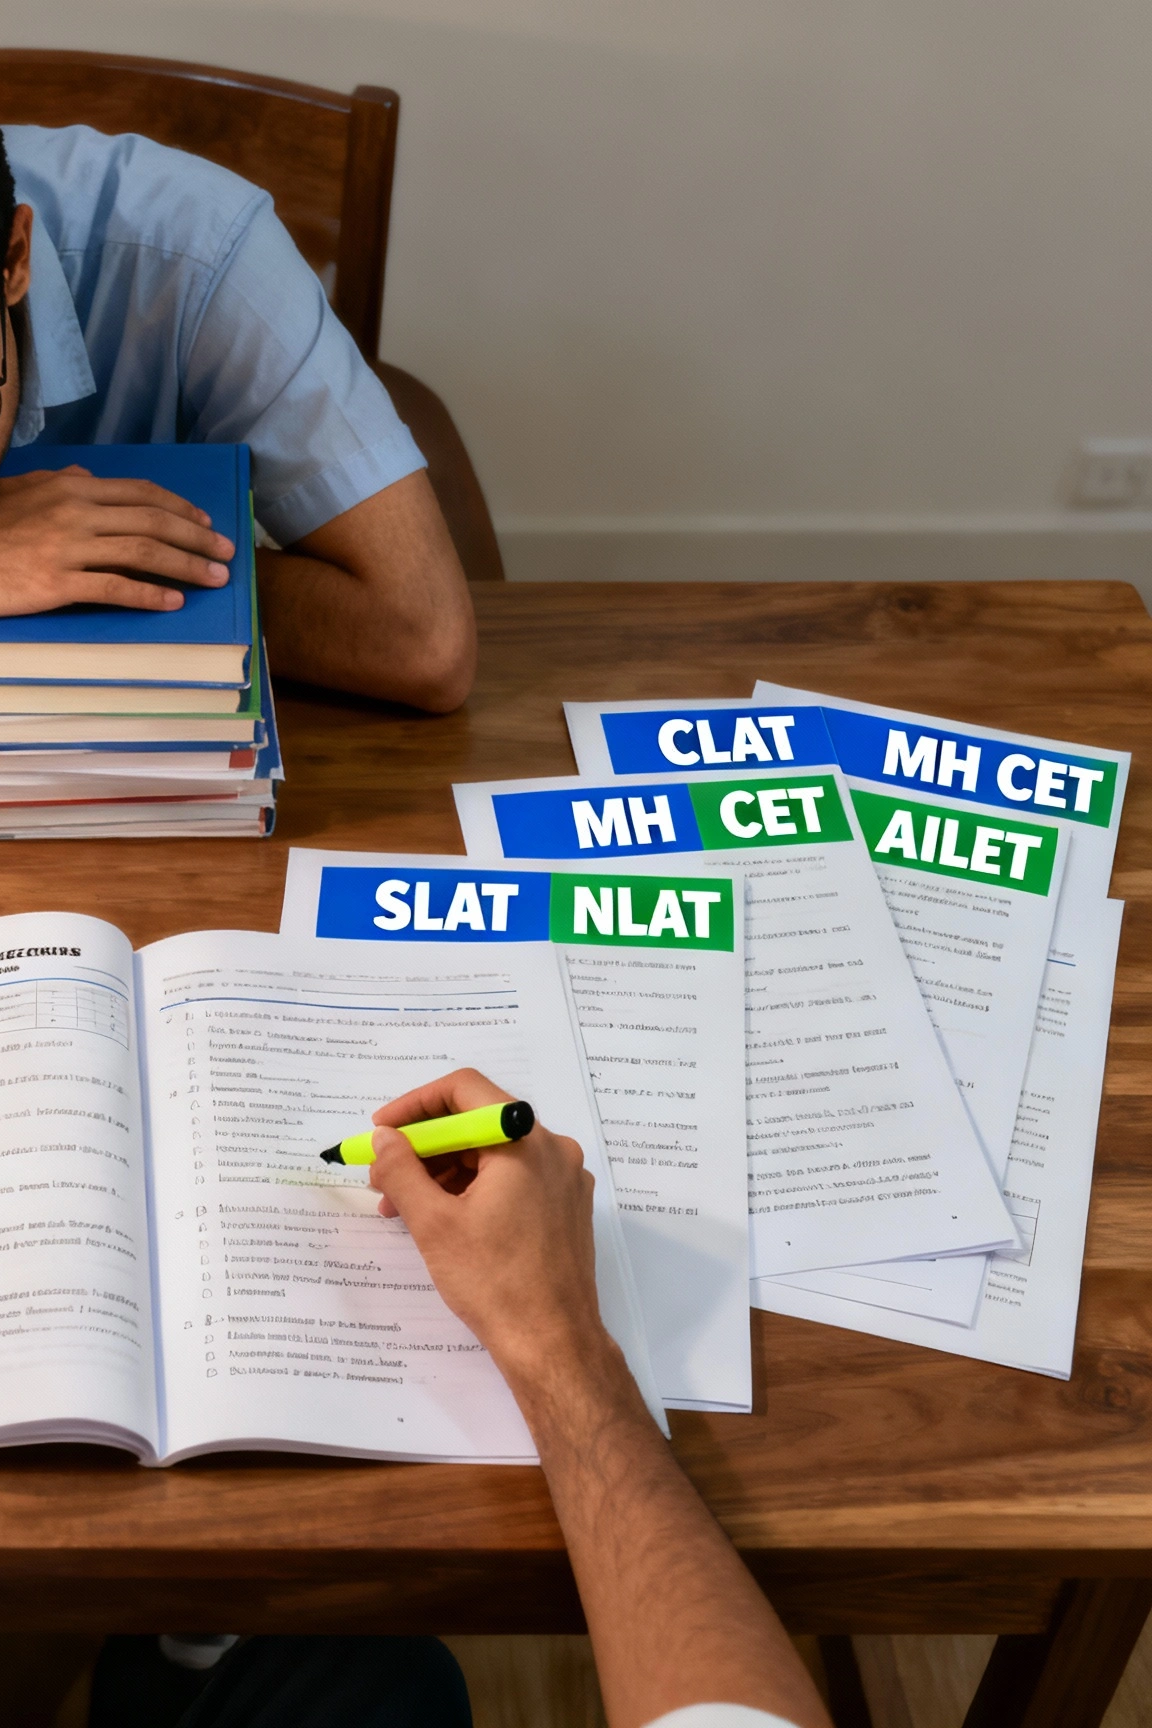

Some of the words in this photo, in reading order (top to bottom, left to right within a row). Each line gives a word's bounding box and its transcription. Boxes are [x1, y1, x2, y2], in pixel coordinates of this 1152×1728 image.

[658, 715, 795, 765] CLAT
[882, 729, 982, 792] MH
[996, 753, 1104, 813] CET
[571, 794, 677, 848] MH
[719, 786, 825, 838] CET
[874, 809, 1043, 880] AILET
[373, 879, 519, 931] SLAT
[573, 886, 721, 938] NLAT
